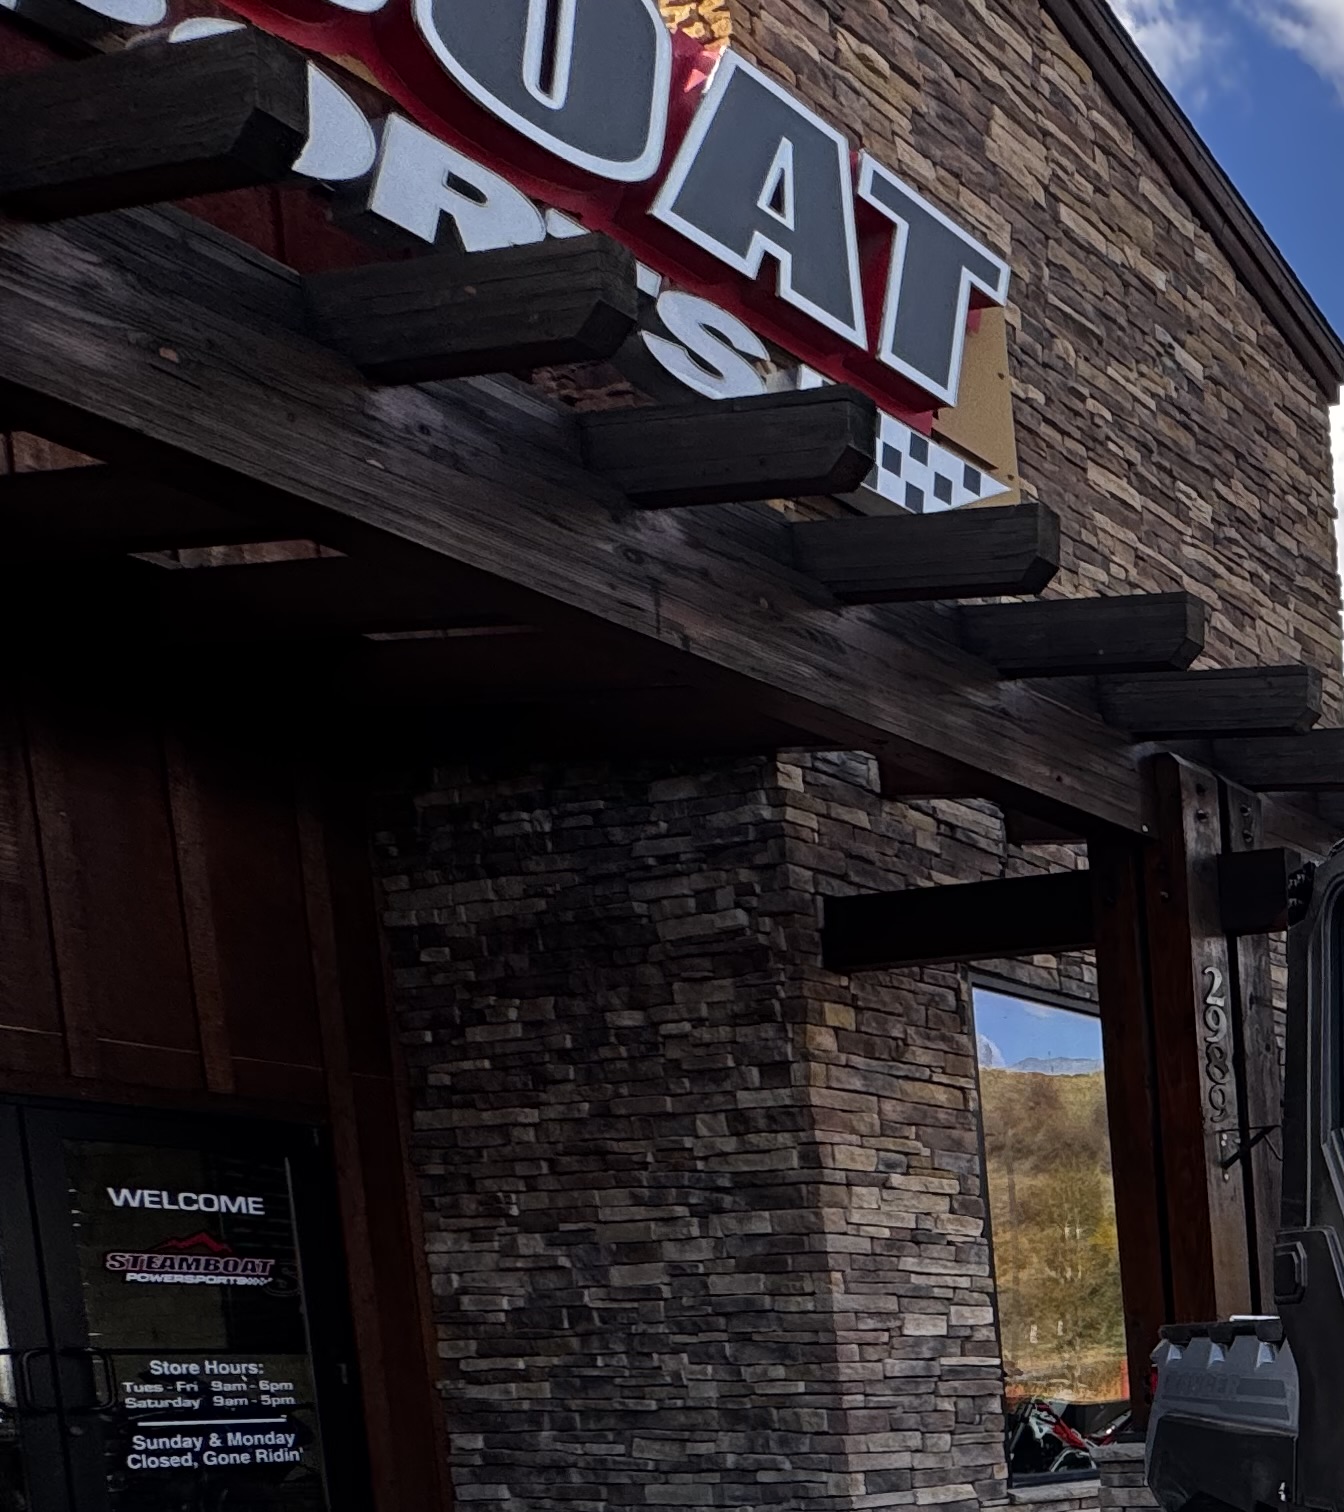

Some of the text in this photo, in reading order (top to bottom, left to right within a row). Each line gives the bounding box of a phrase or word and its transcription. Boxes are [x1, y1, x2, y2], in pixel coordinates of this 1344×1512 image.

[1203, 966, 1231, 1123] 2989
[107, 1187, 266, 1215] WELCOME
[106, 1252, 275, 1276] STEAMBOAT
[126, 1271, 249, 1286] POWERSPORTS
[150, 1360, 264, 1375] Store Hours:
[122, 1382, 164, 1392] Tues
[176, 1381, 199, 1392] Fri
[211, 1381, 247, 1392] 9am
[259, 1380, 293, 1393] 6pm
[125, 1397, 200, 1409] Saturday
[213, 1395, 249, 1406] 9am
[261, 1394, 296, 1408] 5pm
[132, 1431, 295, 1451] Sunday & Monday
[127, 1447, 303, 1469] Closed, Gone Ridin'
